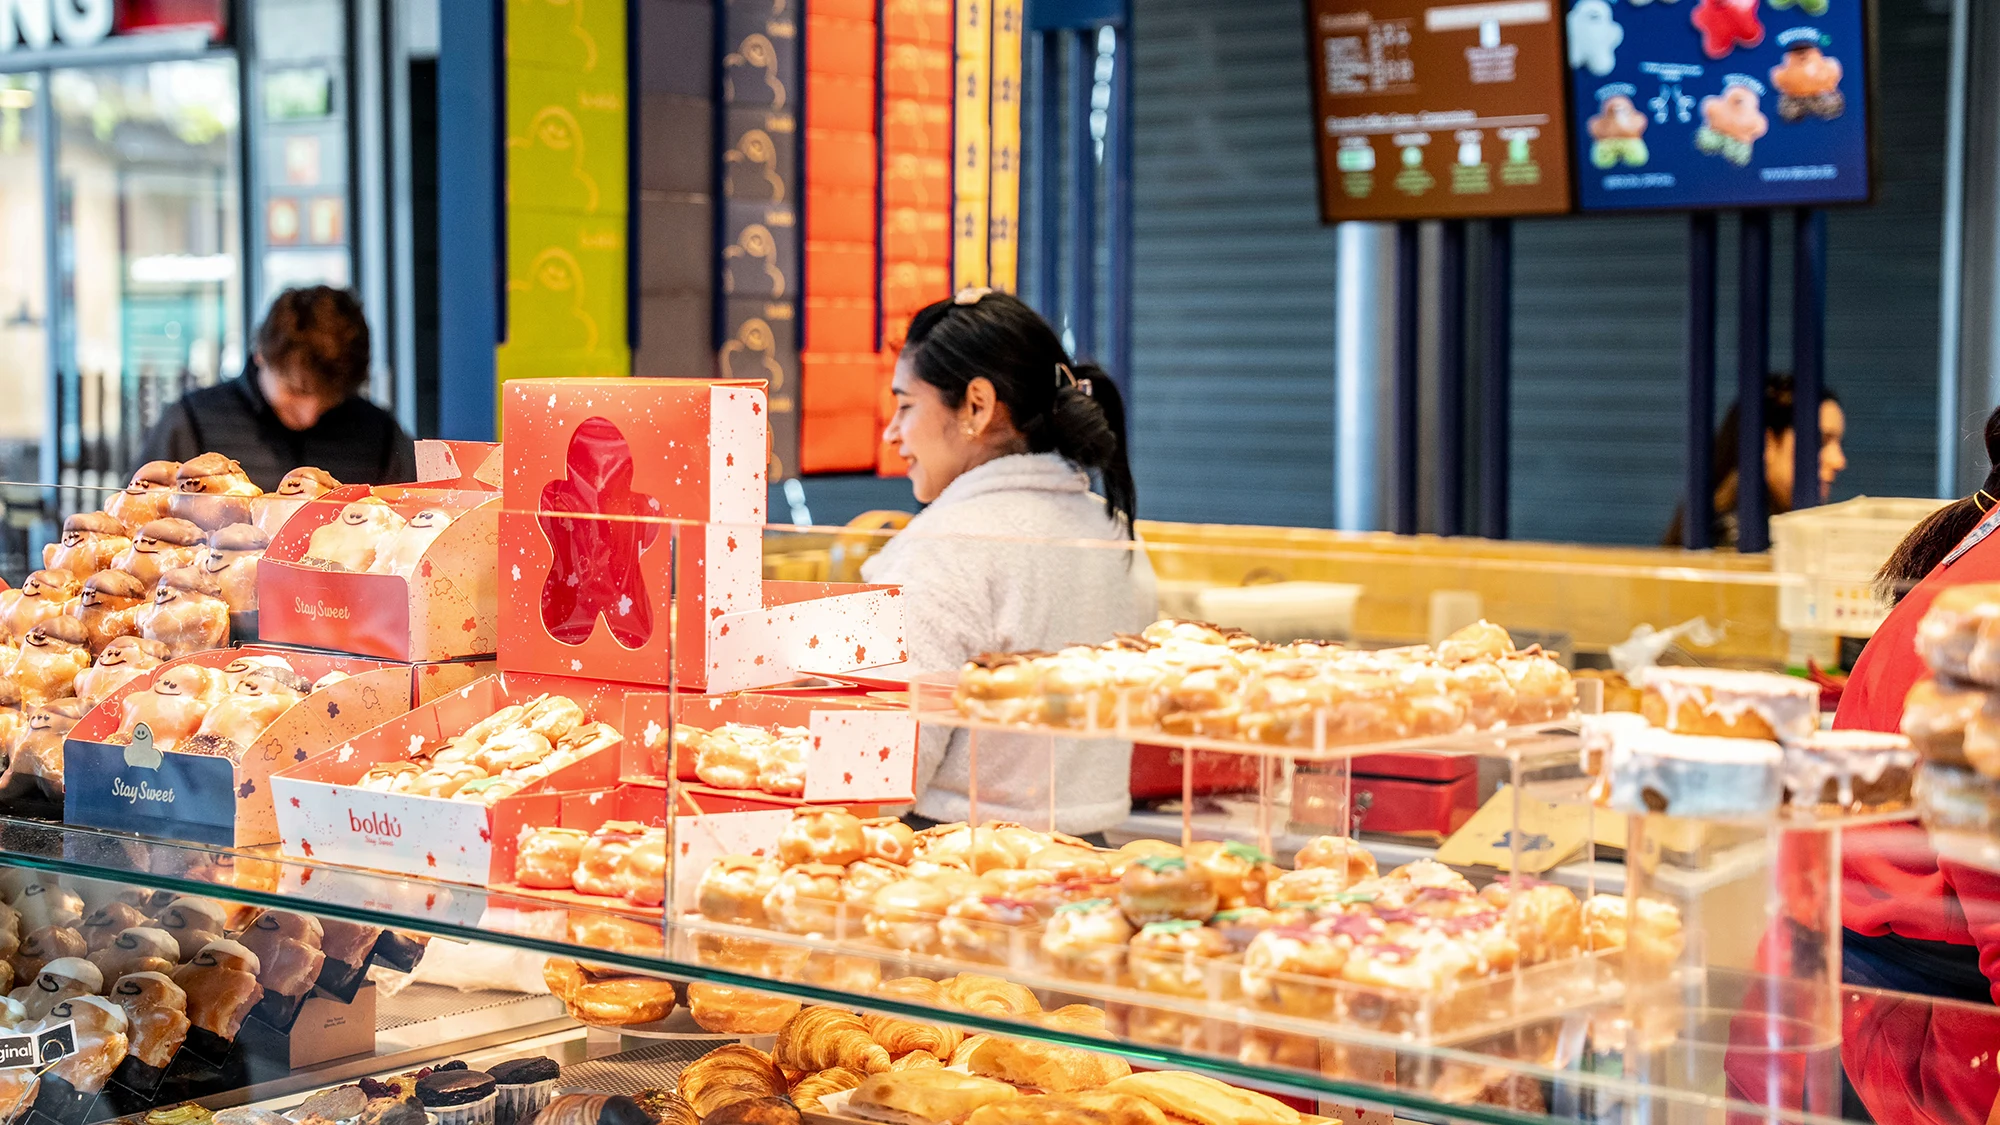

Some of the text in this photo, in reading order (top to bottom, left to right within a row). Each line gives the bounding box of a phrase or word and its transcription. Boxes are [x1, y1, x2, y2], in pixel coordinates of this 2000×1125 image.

[294, 596, 351, 621] Stay Sweet
[112, 777, 175, 804] Stay Sweet
[348, 808, 402, 838] boldú
